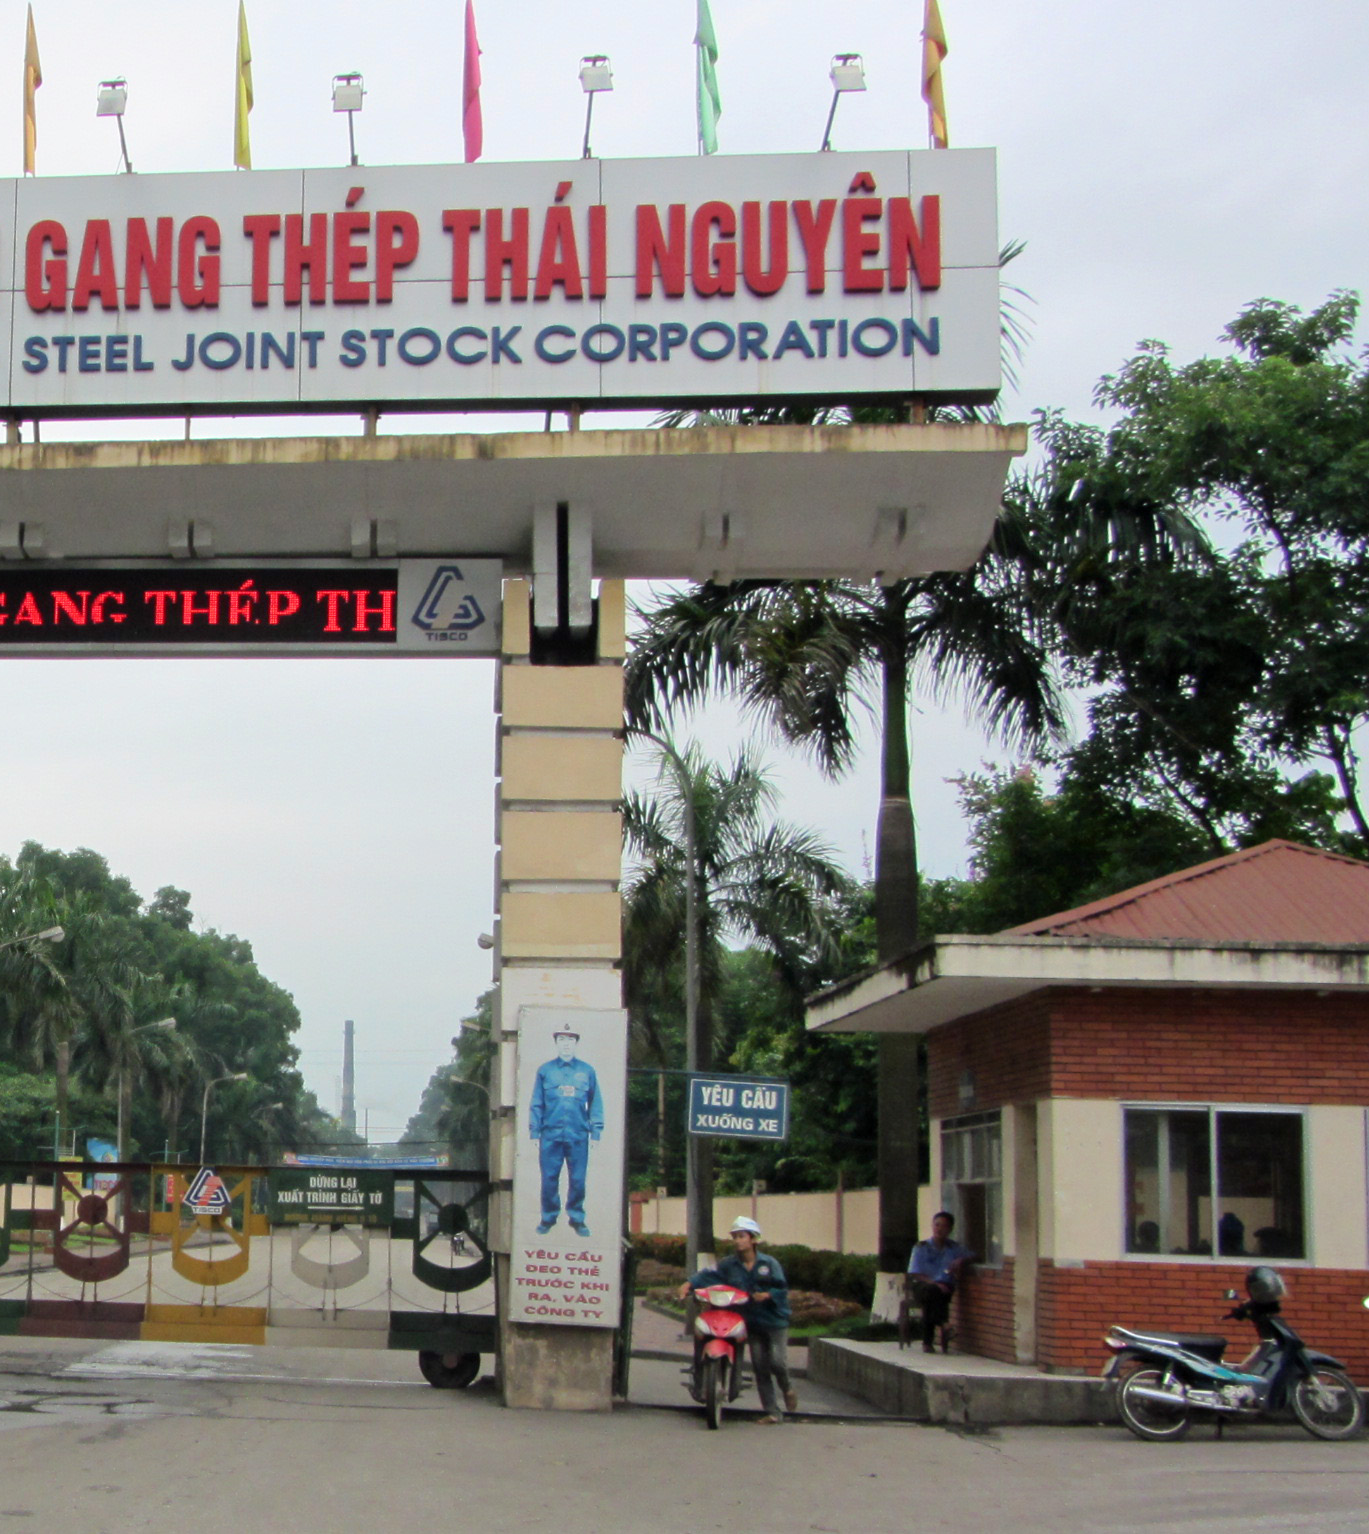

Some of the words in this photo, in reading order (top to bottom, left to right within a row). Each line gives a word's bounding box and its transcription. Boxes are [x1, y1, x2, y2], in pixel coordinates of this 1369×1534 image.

[24, 215, 221, 314] GANG
[242, 186, 420, 308] THÉP
[441, 181, 607, 304] THÁI
[634, 171, 941, 299] NGUYÊN
[21, 335, 155, 374] STEEL
[170, 331, 326, 371] JOINT
[338, 326, 523, 368] STOCK
[534, 316, 940, 365] CORPORATION
[316, 590, 397, 632] TH
[424, 631, 469, 642] TISCO
[701, 1084, 734, 1107] YÊU
[740, 1086, 777, 1110] CẦU
[695, 1113, 754, 1131] XUỐNG
[758, 1118, 778, 1132] XE
[340, 1176, 357, 1191] LẠI
[277, 1188, 304, 1203] XUẤT
[306, 1189, 337, 1204] TRÌNH
[340, 1189, 365, 1204] GIẤY
[524, 1249, 560, 1260] YÊU
[580, 1281, 610, 1292] KHI
[563, 1293, 601, 1304] VÀO
[524, 1305, 576, 1317] CÔNG
[581, 1309, 604, 1319] TY
